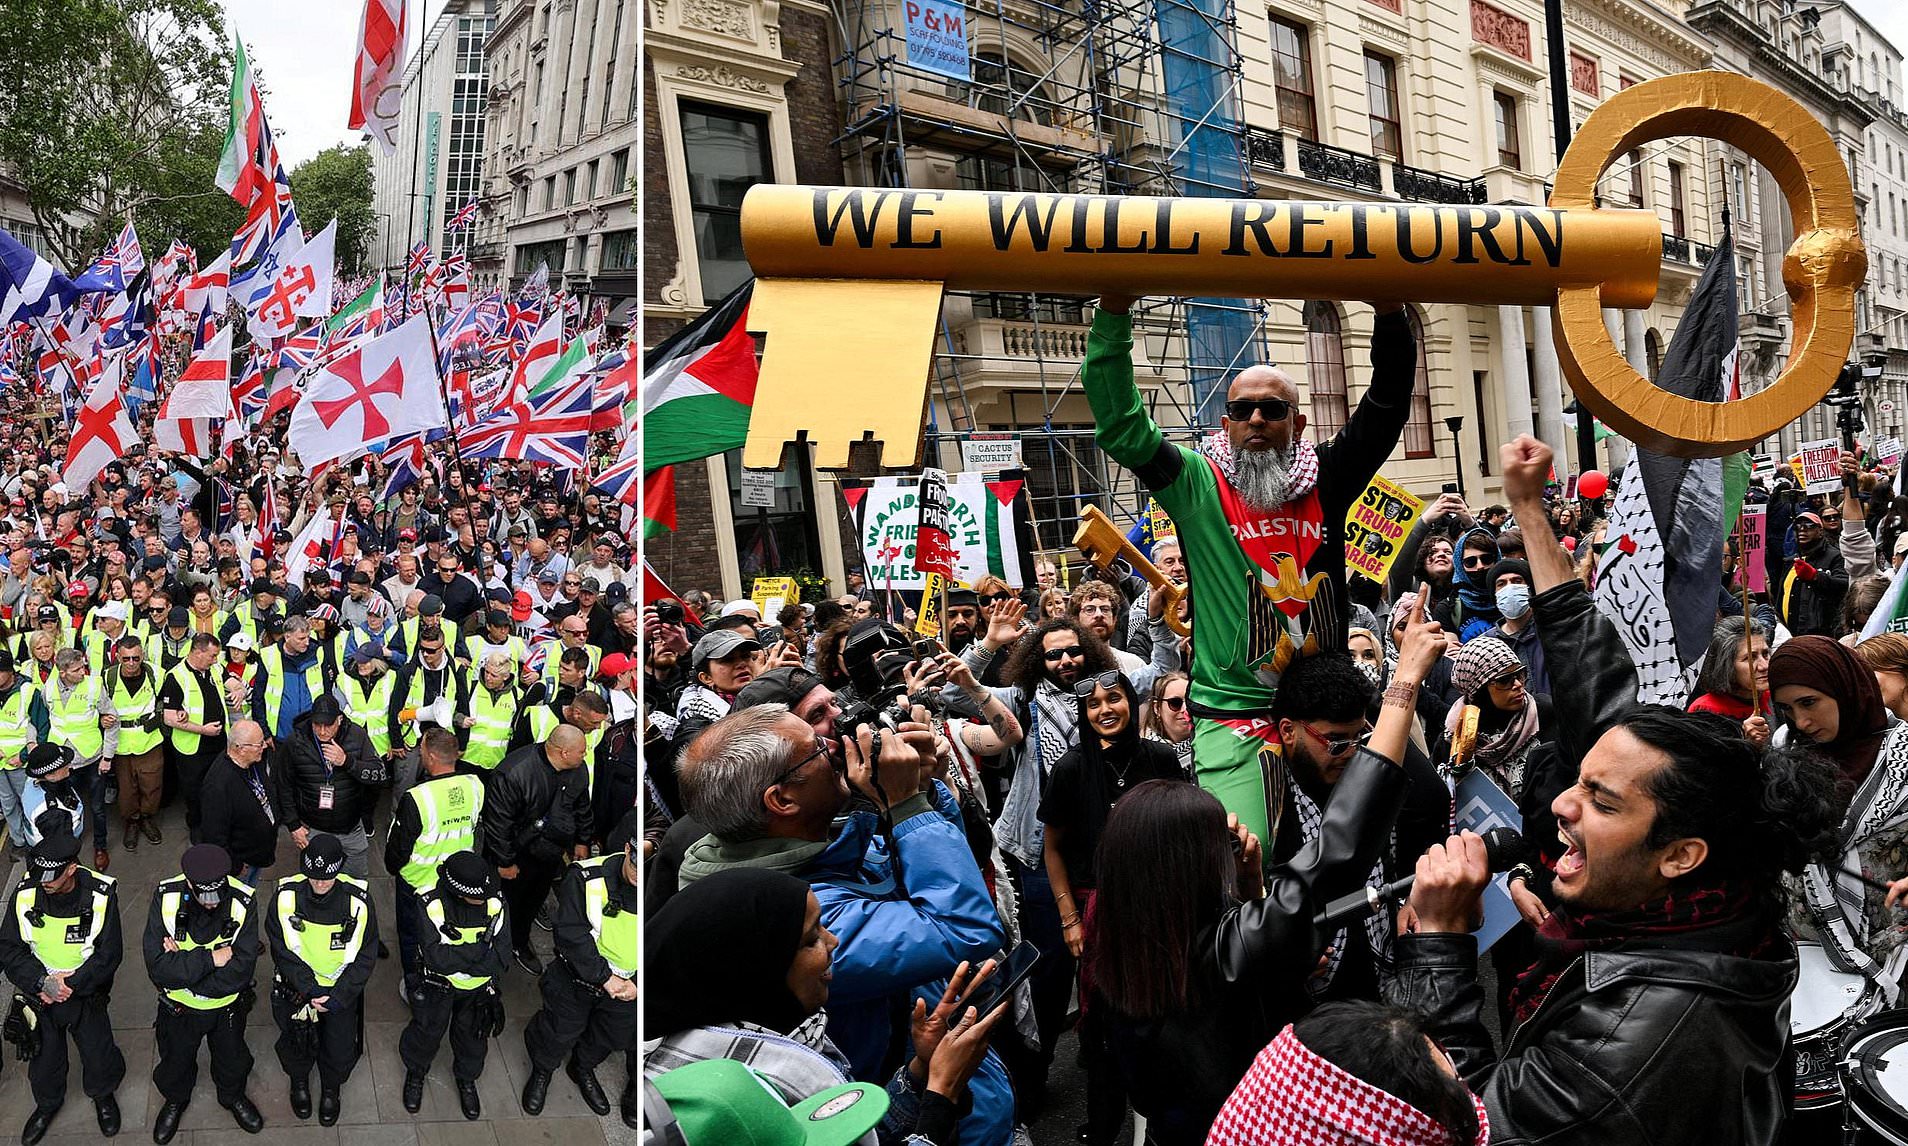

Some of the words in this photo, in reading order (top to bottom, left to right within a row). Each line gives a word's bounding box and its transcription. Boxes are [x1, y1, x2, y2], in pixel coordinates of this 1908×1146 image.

[909, 27, 965, 50] SCAFFOLDING
[810, 187, 944, 250] WE
[985, 193, 1200, 256] WILL
[1221, 200, 1567, 268] RETURN
[969, 454, 1012, 463] SECURITY
[978, 444, 1013, 453] CACTUS
[1803, 447, 1840, 466] FREEDOM
[867, 494, 980, 547] WANDSORTH
[1363, 486, 1414, 524] STOP
[886, 524, 957, 540] FRIES
[1355, 504, 1404, 540] TRUMP
[1345, 522, 1394, 559] STOP
[1345, 544, 1385, 577] ARAGE
